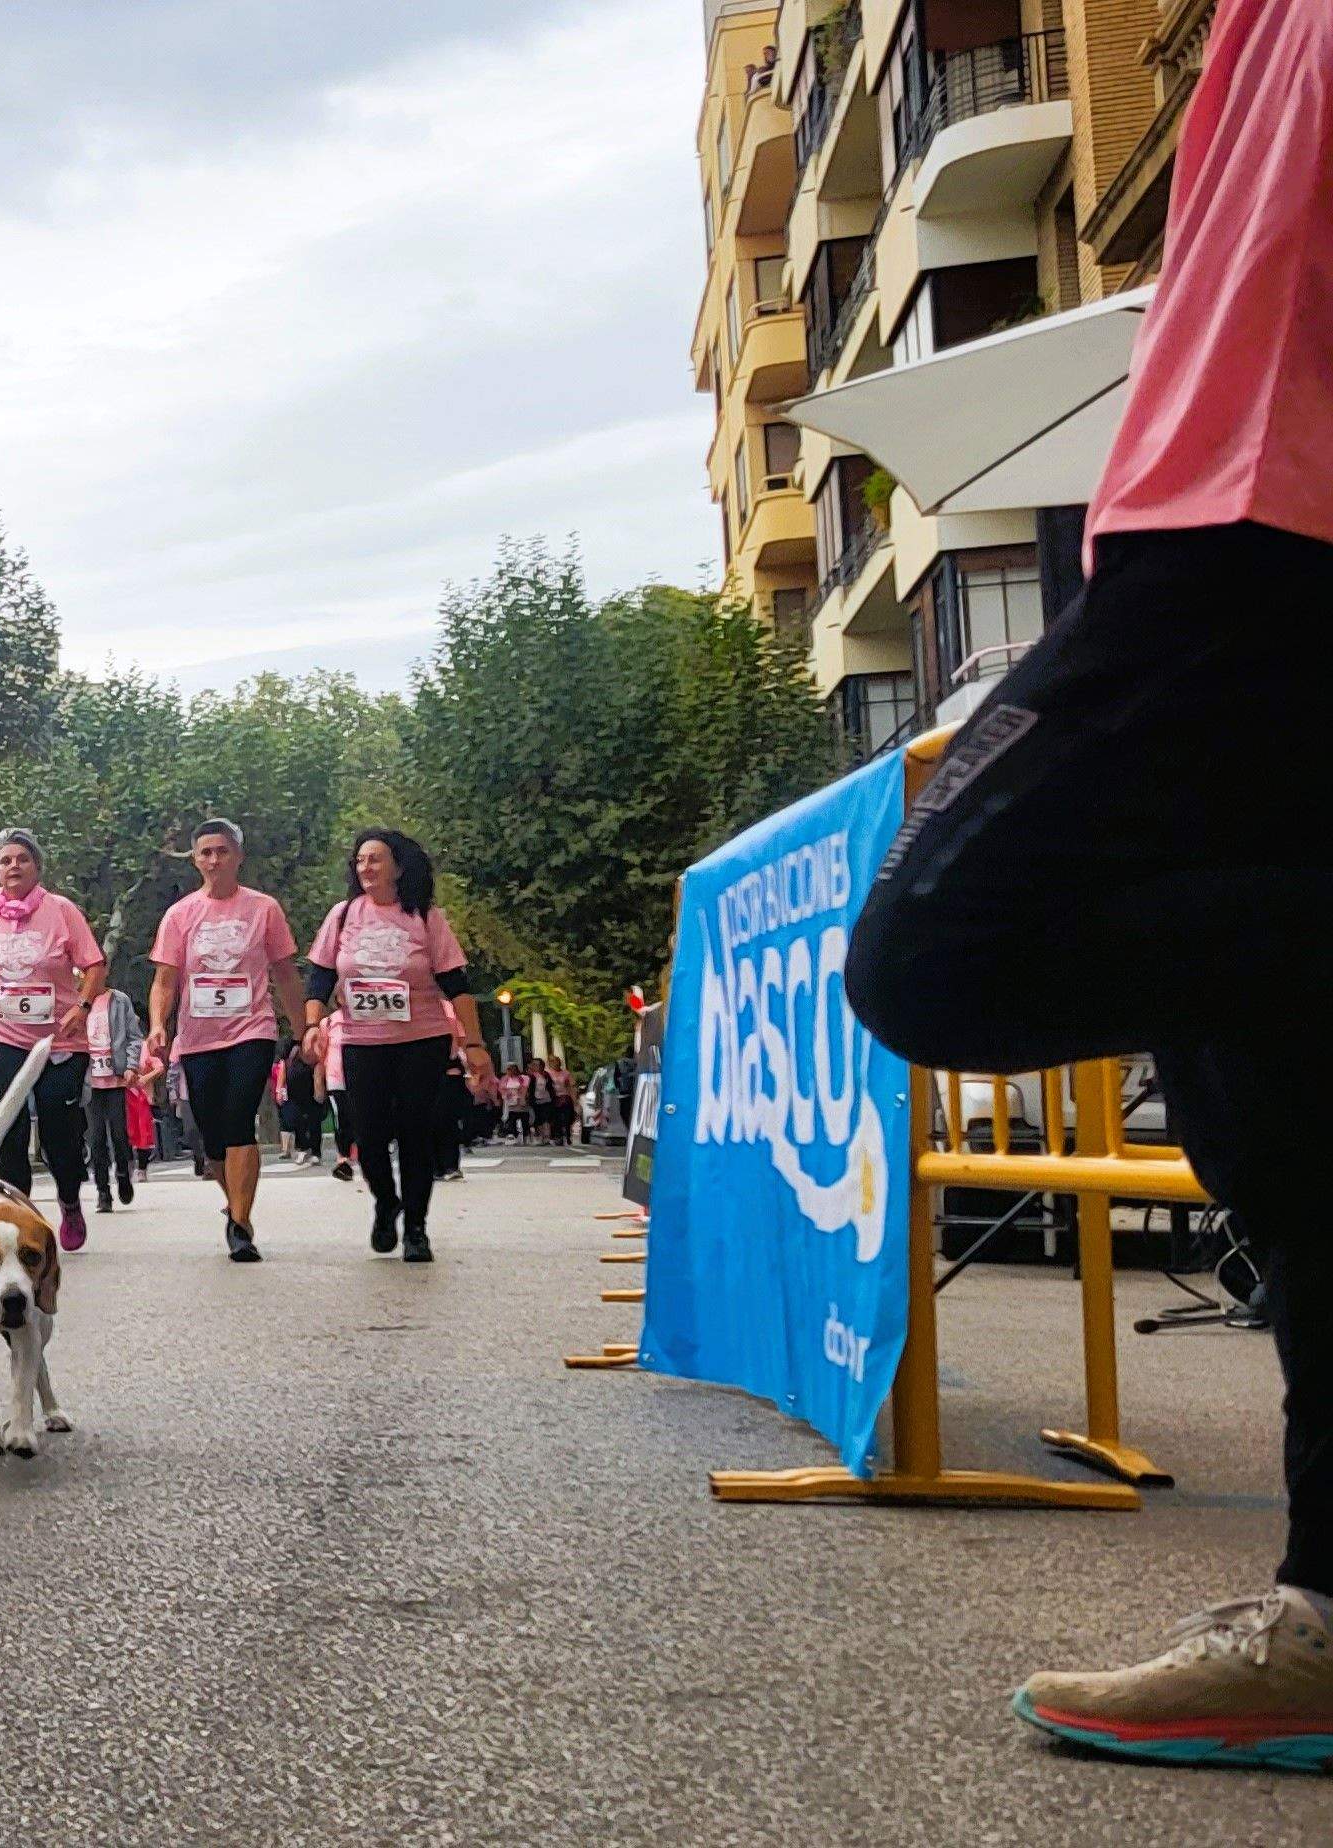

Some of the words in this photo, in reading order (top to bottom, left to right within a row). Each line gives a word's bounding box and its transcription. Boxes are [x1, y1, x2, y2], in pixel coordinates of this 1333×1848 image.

[18, 997, 31, 1014] 6
[213, 989, 227, 1006] 5
[354, 993, 405, 1011] 2916
